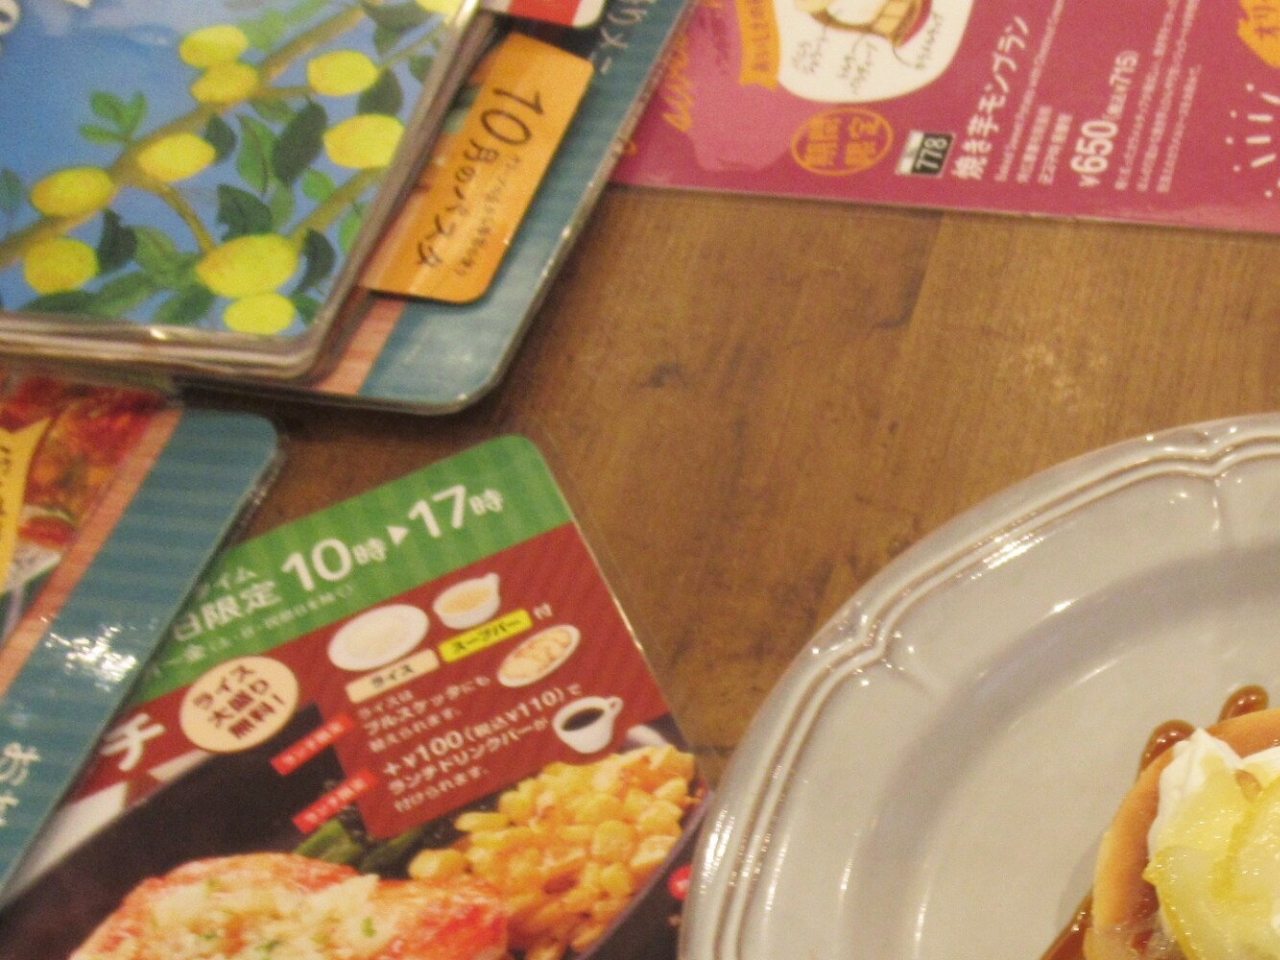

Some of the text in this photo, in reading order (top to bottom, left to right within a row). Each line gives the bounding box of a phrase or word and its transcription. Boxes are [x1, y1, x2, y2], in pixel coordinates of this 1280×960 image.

[951, 15, 1031, 181] 焼き芋モンブラン
[915, 135, 949, 172] 778
[281, 538, 388, 592] 10時
[406, 483, 504, 538] 17時
[450, 619, 525, 653] スープバー
[192, 664, 256, 711] ライス
[370, 664, 418, 688] ライス
